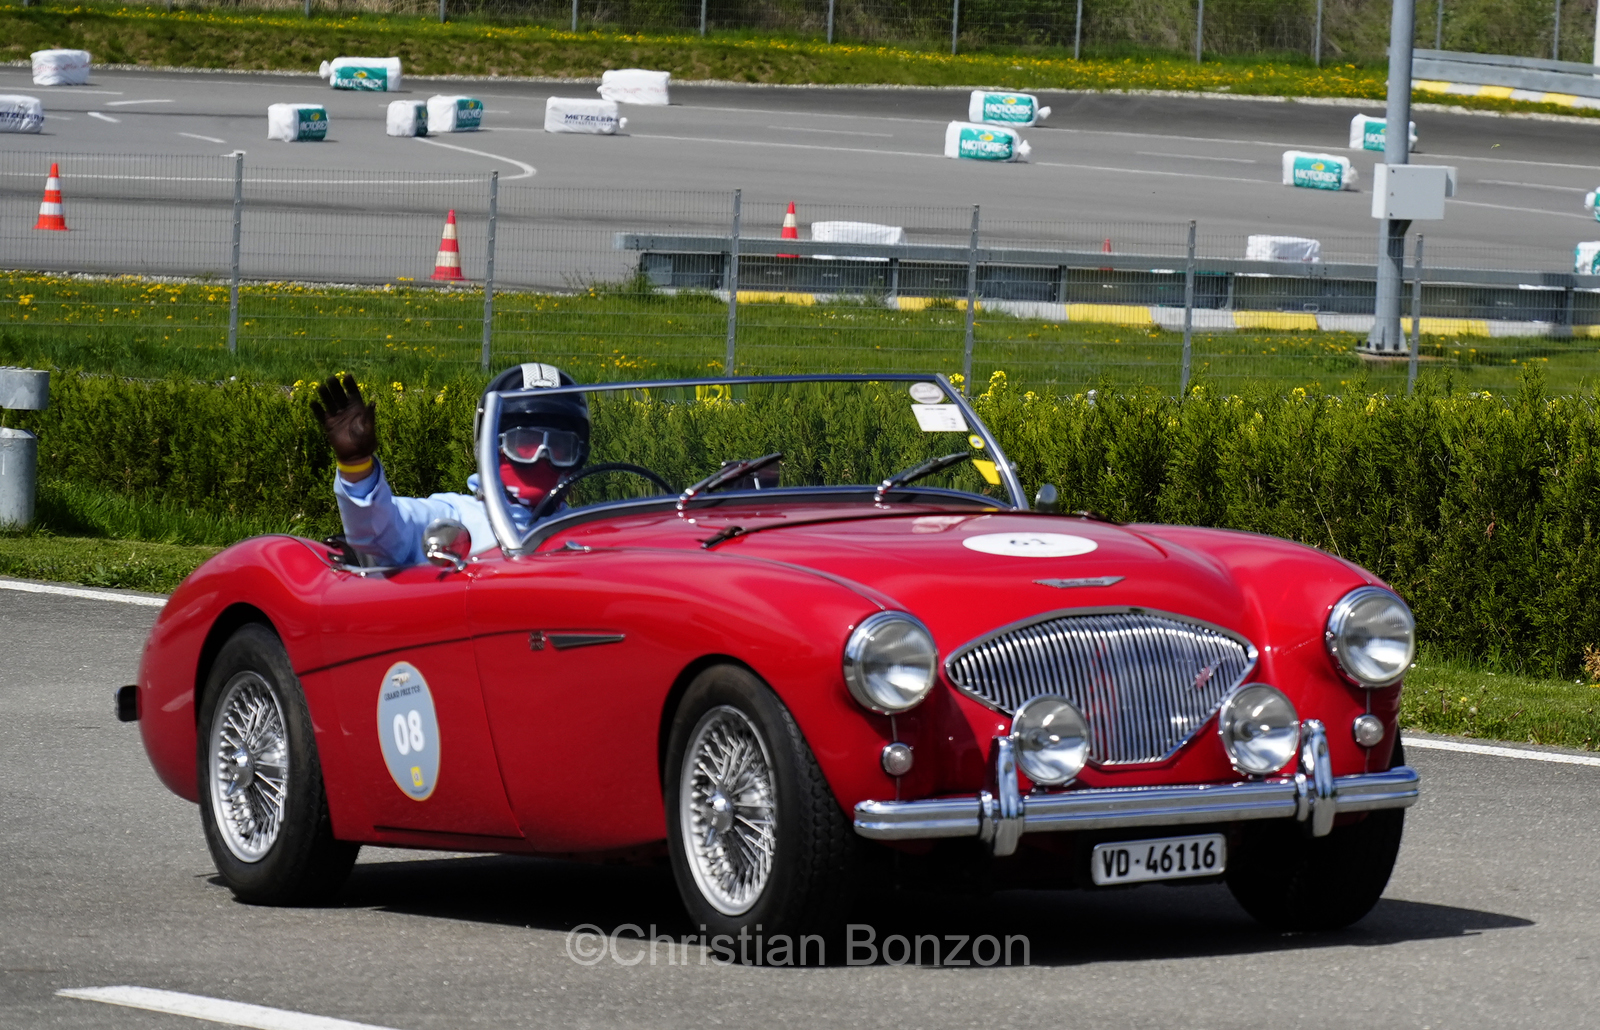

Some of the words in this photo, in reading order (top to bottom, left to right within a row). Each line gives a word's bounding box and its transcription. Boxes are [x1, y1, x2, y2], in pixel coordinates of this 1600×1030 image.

[984, 103, 1031, 114] MOTOREX
[961, 139, 1010, 152] MOTOREX
[1295, 169, 1339, 181] MOTOREX
[384, 690, 400, 701] GRAND
[411, 684, 421, 695] TCS
[393, 709, 425, 756] 08
